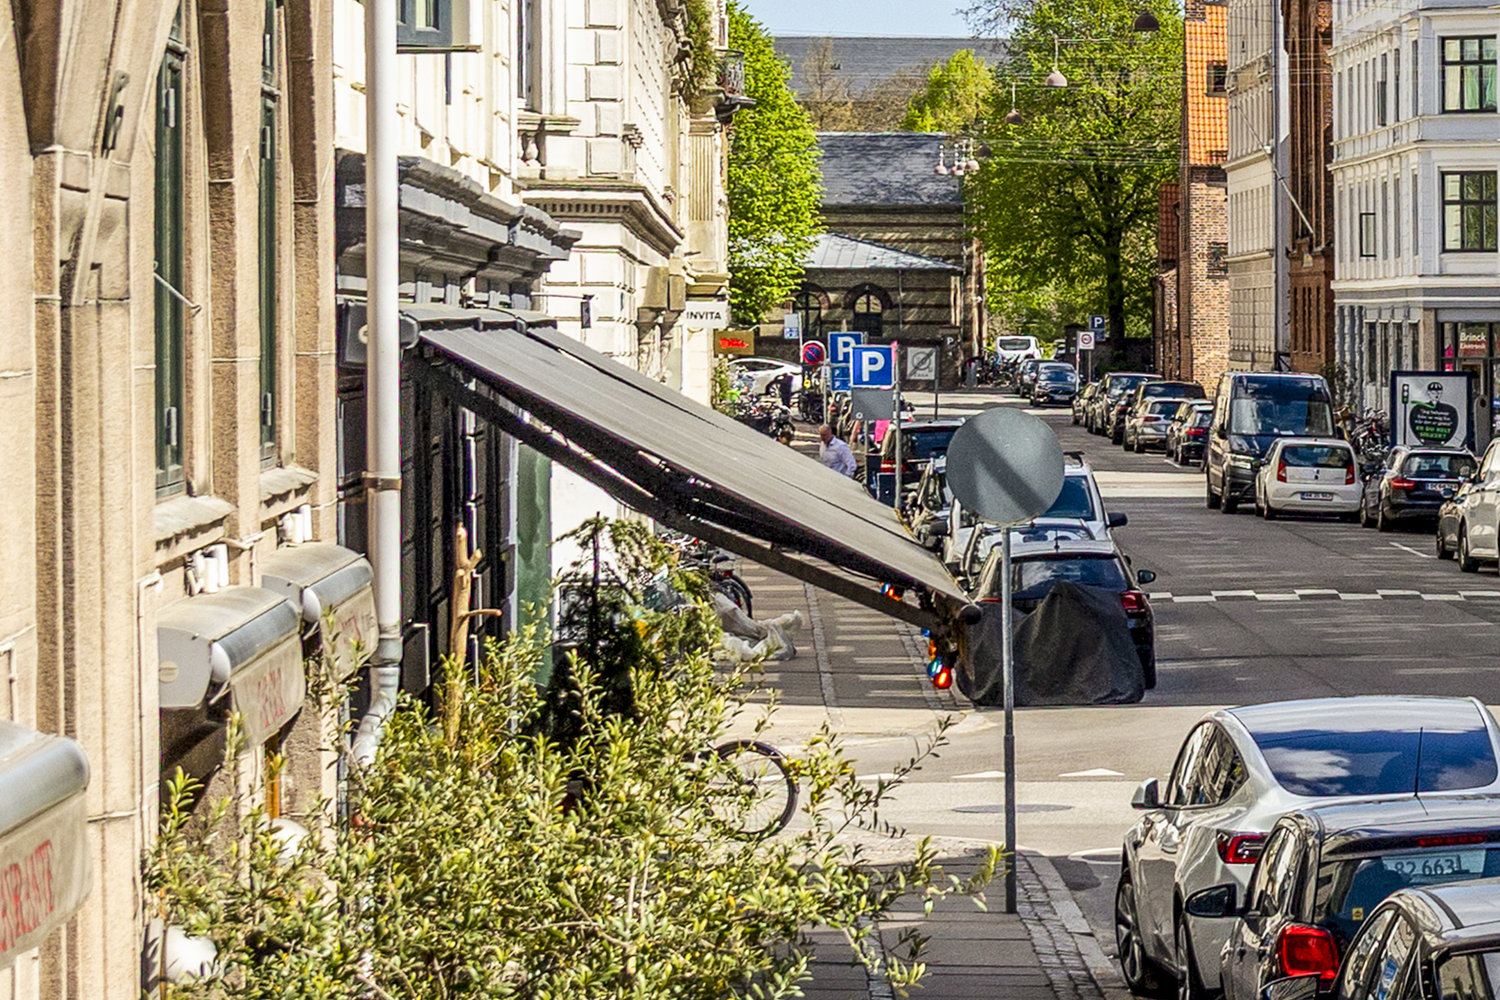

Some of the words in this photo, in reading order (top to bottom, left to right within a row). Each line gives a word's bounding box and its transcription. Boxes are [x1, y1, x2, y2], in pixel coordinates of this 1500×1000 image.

[686, 311, 722, 319] INVITA
[1094, 317, 1103, 328] P
[1459, 332, 1487, 342] Brinck
[837, 336, 857, 361] P
[861, 351, 885, 382] P
